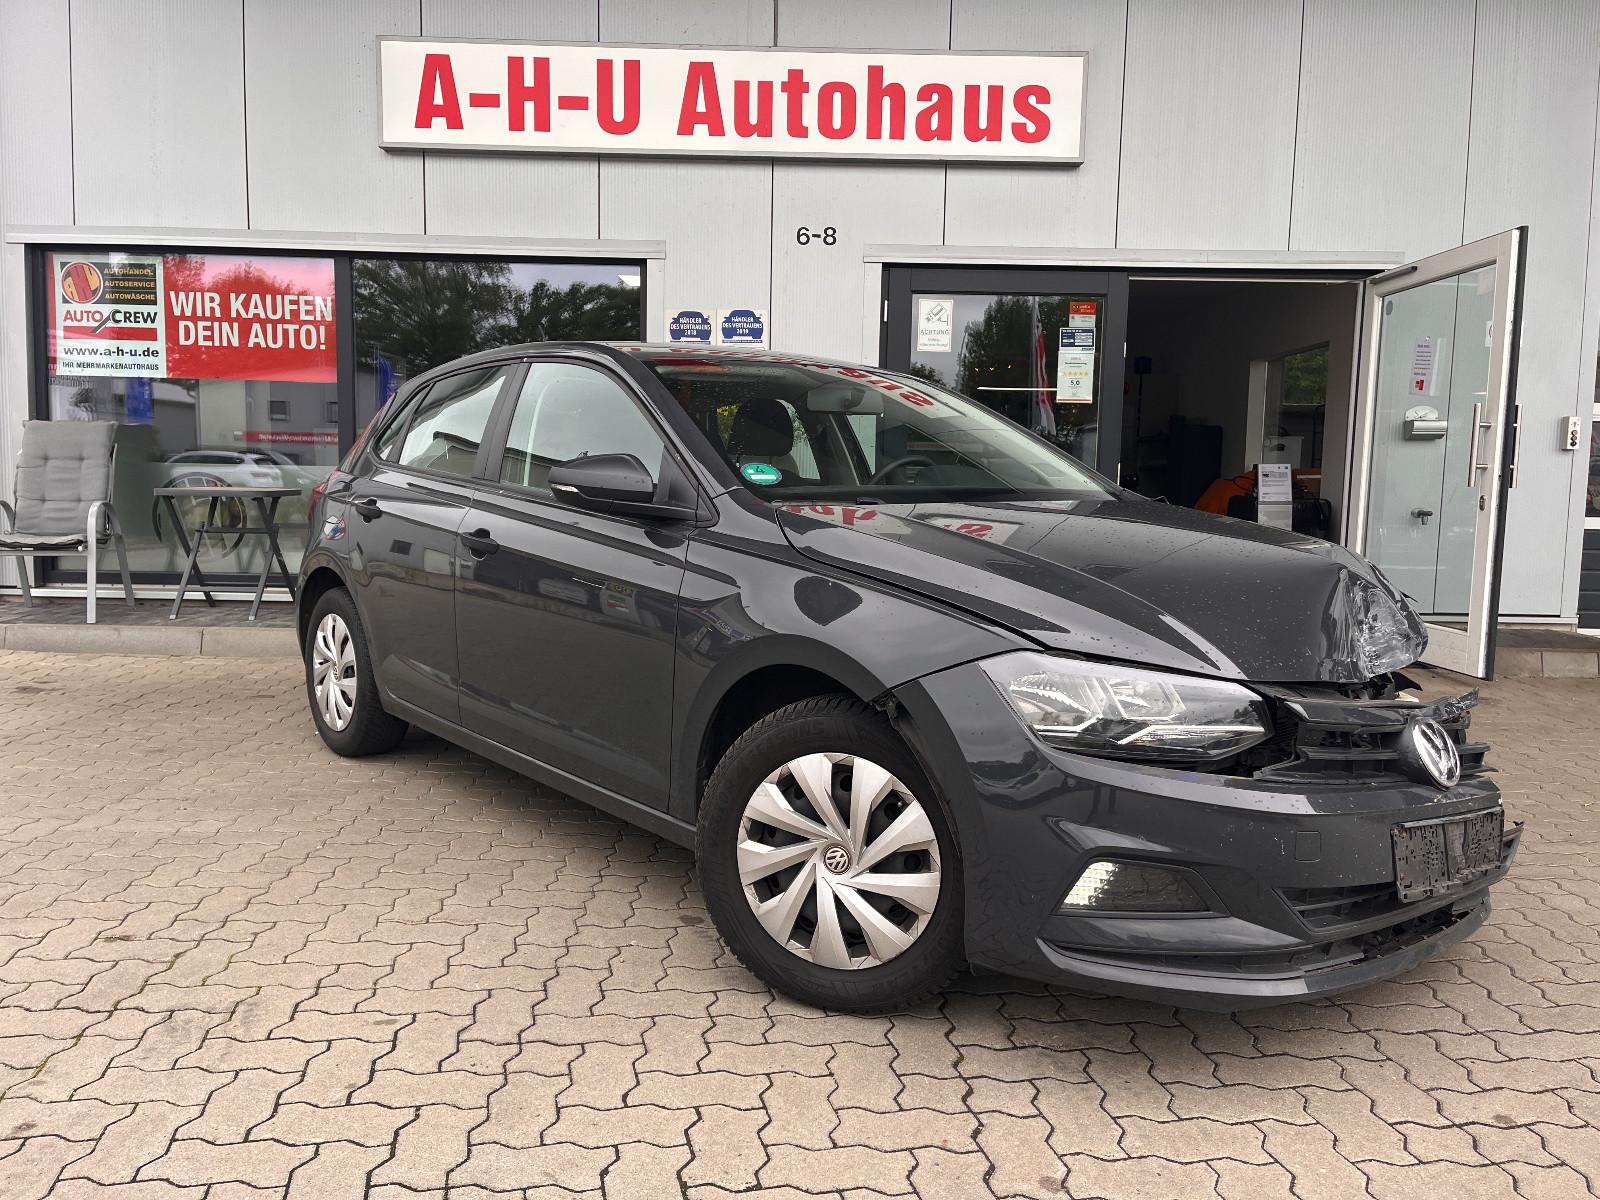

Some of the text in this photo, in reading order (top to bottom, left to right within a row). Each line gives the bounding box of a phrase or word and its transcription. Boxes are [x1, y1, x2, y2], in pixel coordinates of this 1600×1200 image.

[414, 53, 1052, 143] A-H-U Autohaus
[796, 226, 838, 246] 6-8
[103, 267, 154, 276] AUTOHANDEL
[104, 280, 156, 288] AUTOSERVICE
[105, 292, 156, 301] AUTOWÄSCHE
[169, 290, 333, 322] WIR KAUFEN
[63, 309, 158, 324] AUTO CREW
[178, 321, 327, 350] DEIN AUTO!
[63, 346, 160, 358] www.a-h-u.de
[62, 361, 159, 371] IHR MEHRMARKENAUTOHAUS
[1070, 379, 1081, 387] 5,0
